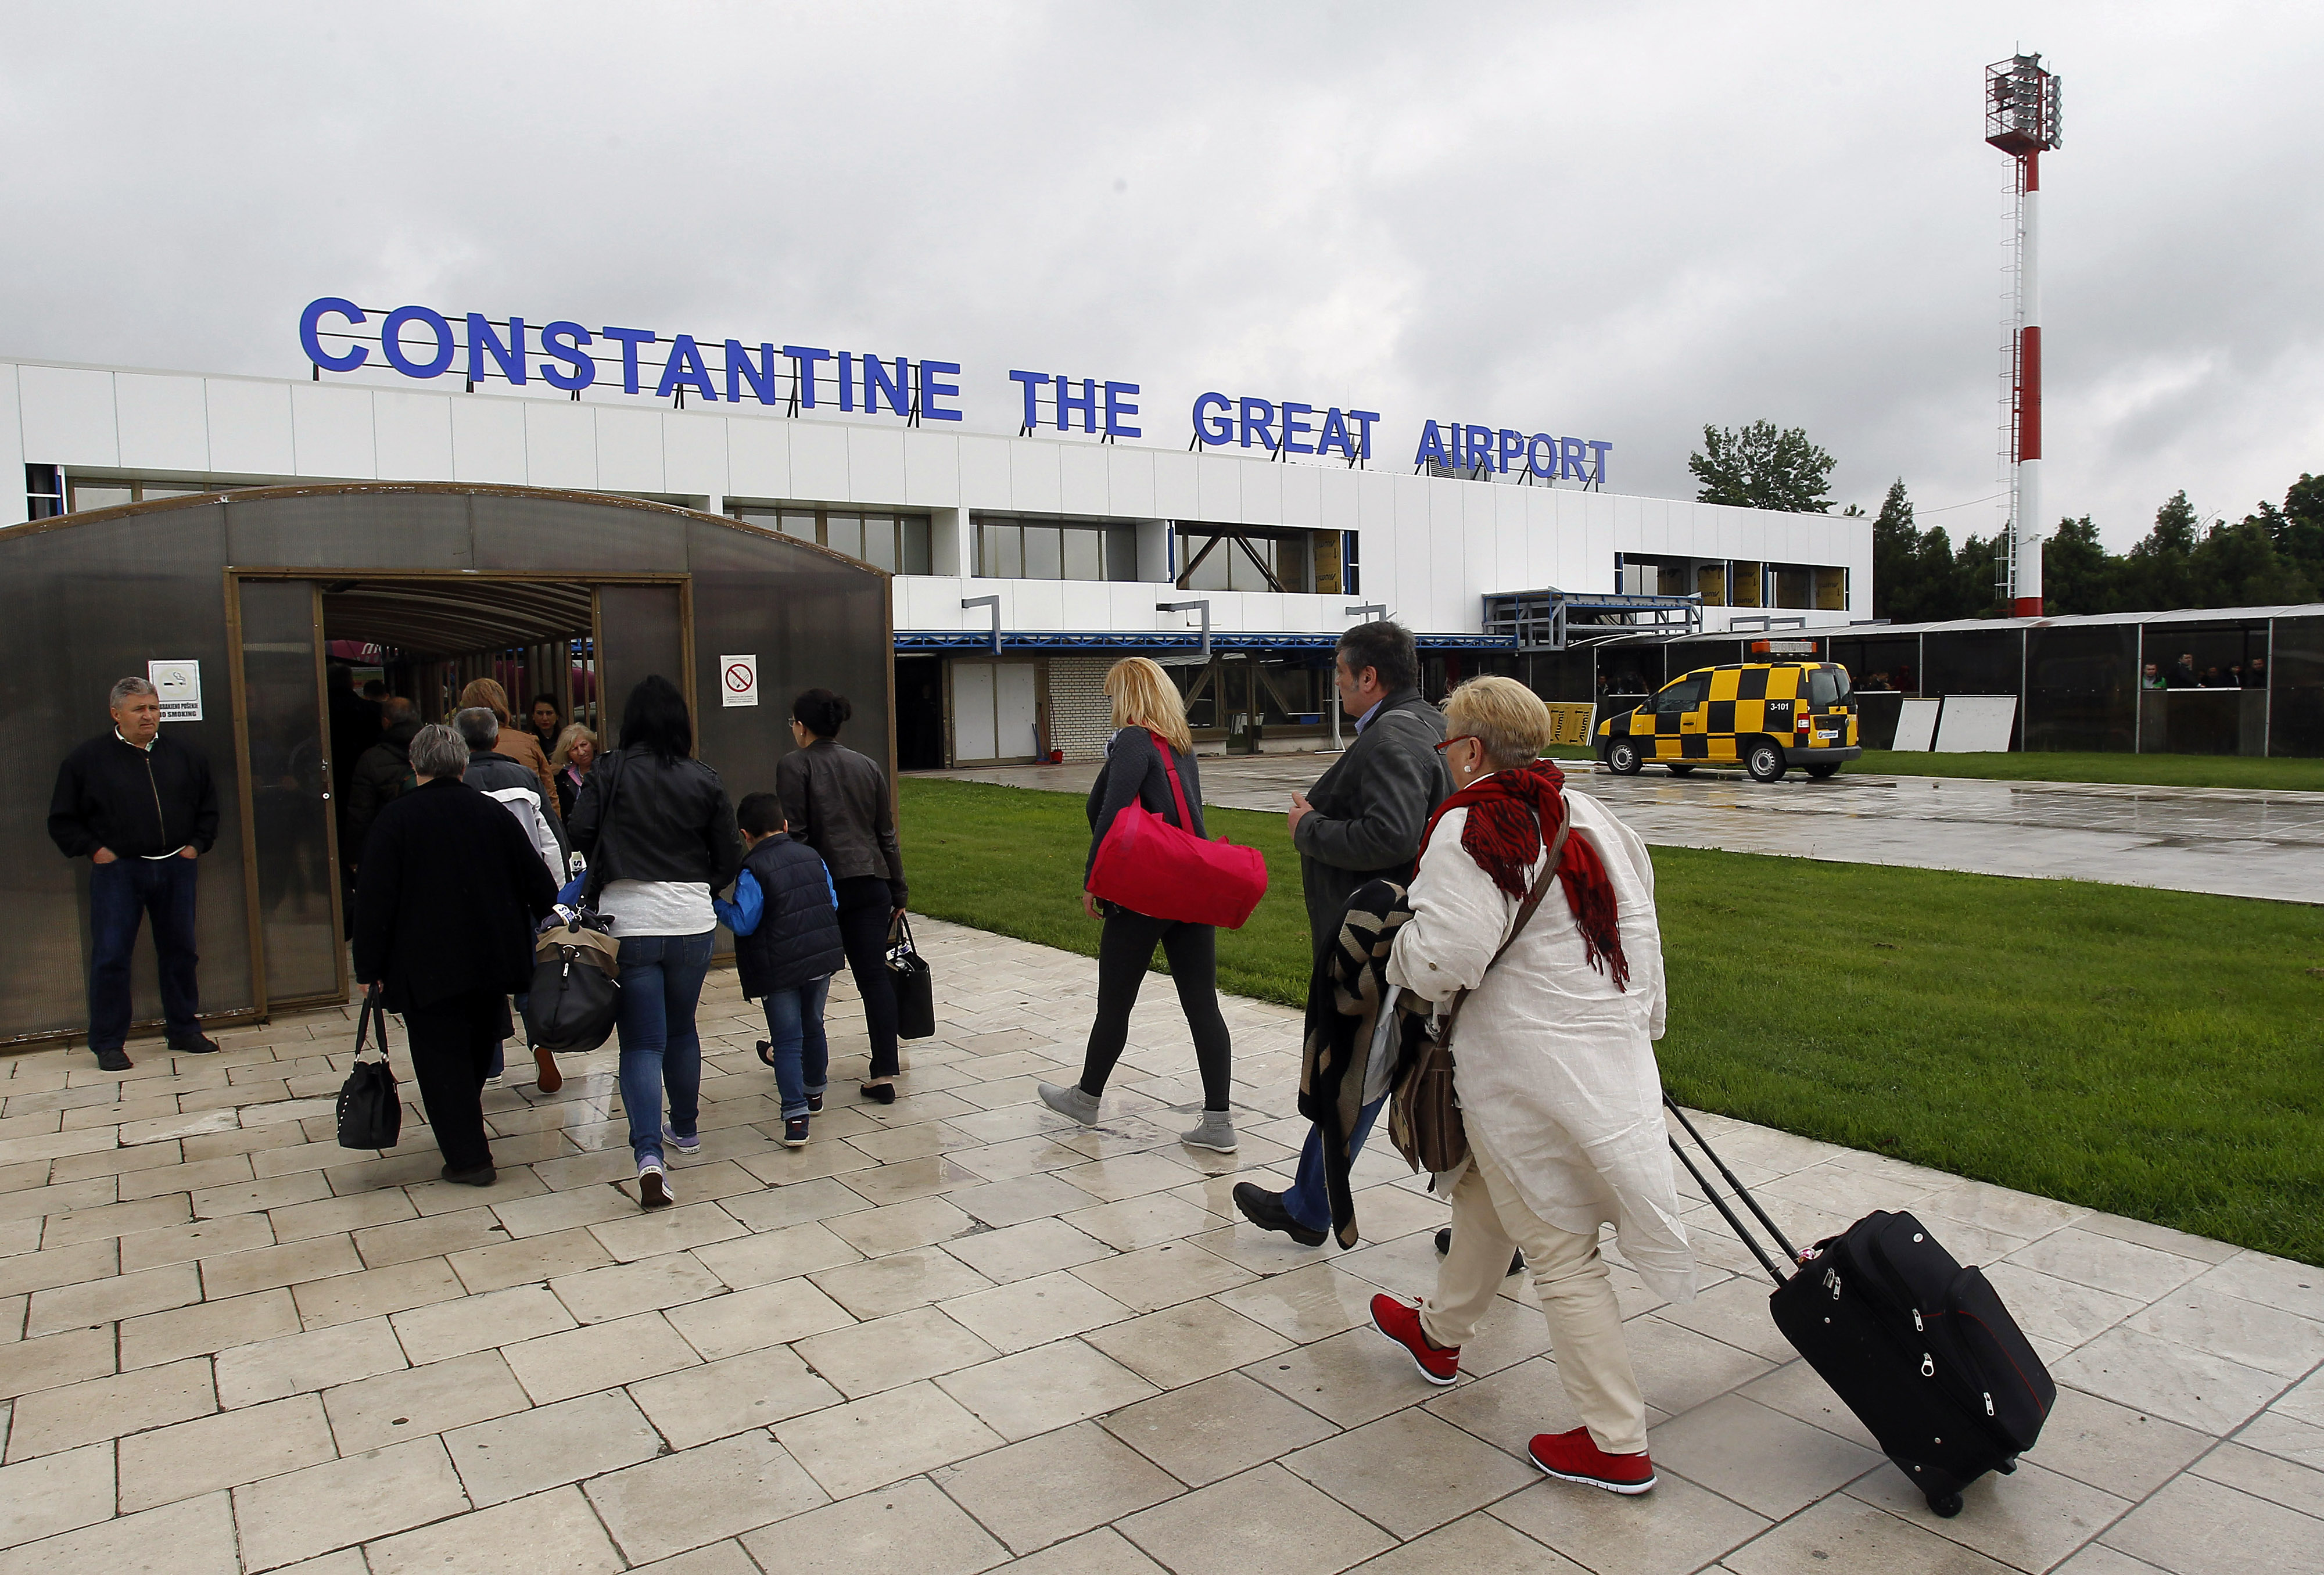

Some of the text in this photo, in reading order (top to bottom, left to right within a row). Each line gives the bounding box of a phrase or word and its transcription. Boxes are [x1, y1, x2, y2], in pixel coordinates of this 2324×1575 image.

[300, 297, 1613, 483] CONSTANTINE THE GREAT AIRPORT
[1770, 702, 1789, 711] 3-101
[1555, 711, 1565, 741] Alumil
[1579, 711, 1590, 742] Alumil
